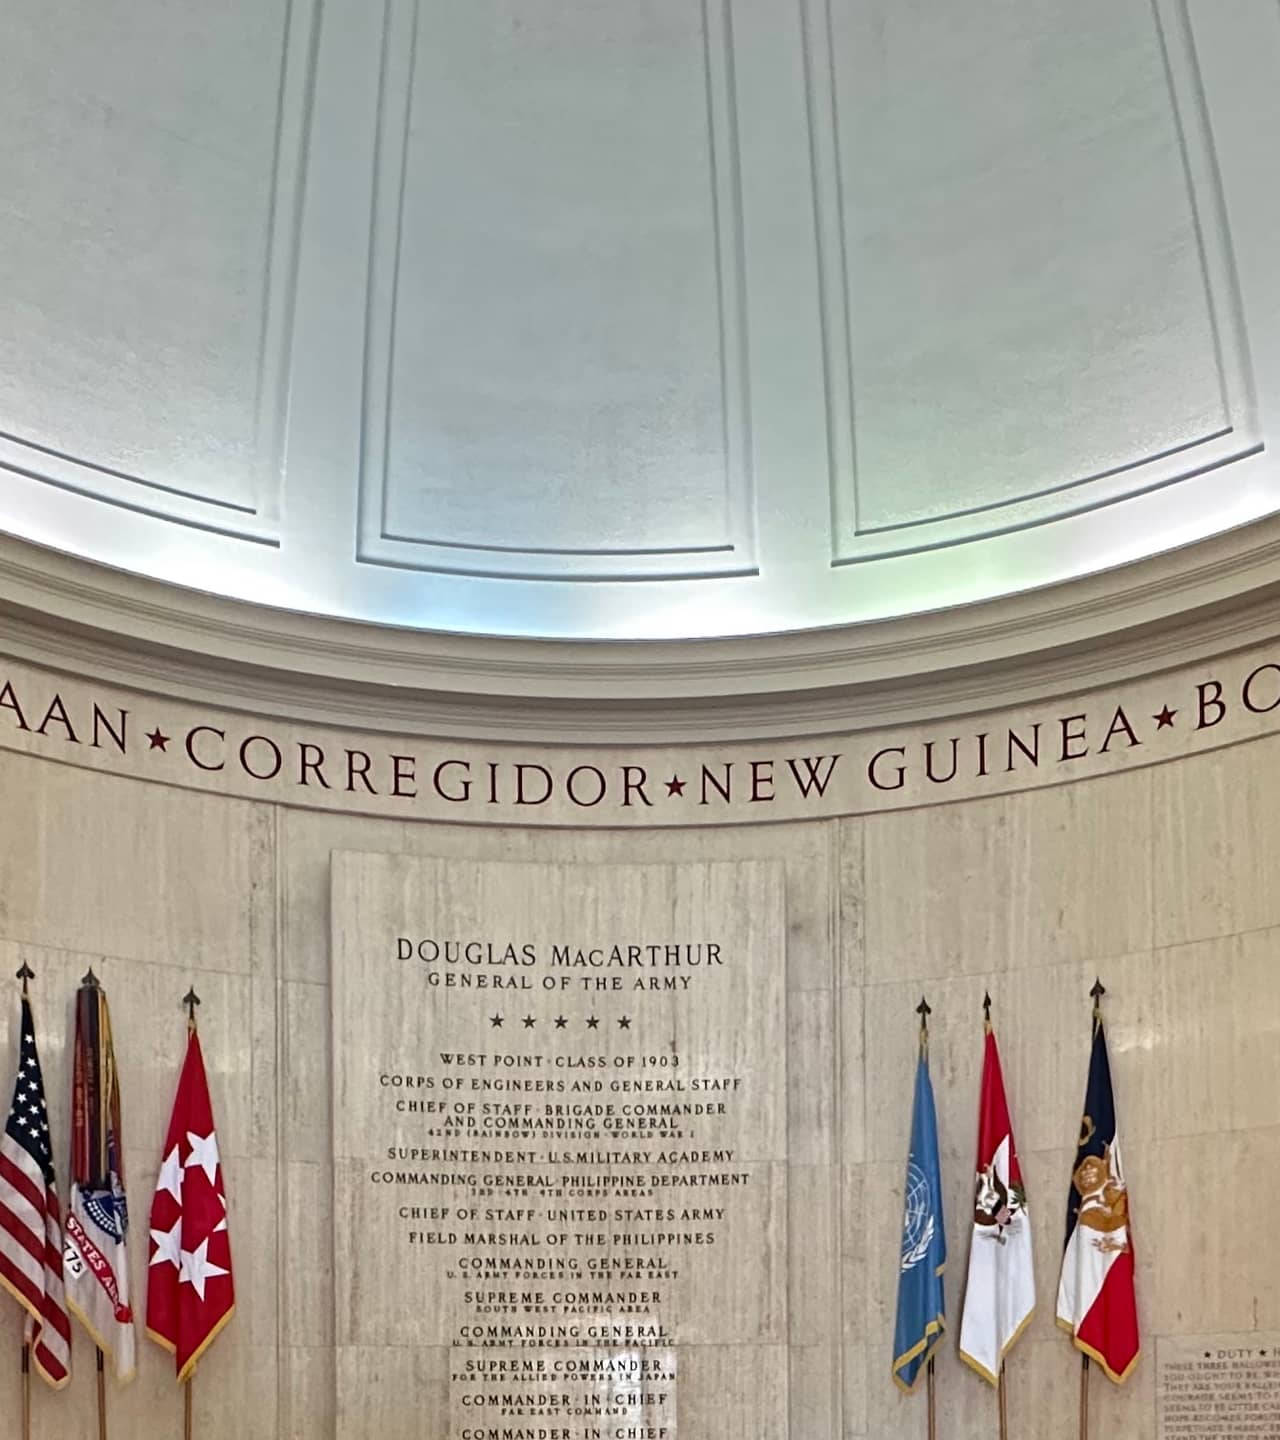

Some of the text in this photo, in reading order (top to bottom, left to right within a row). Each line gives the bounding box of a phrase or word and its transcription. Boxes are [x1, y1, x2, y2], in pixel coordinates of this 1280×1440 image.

[185, 726, 653, 807] CORREGIDOR
[699, 754, 843, 804] NEW
[868, 704, 1143, 791] GUINEA
[397, 938, 536, 967] DOUGLAS
[428, 972, 692, 990] GENERAL OF THE ARMY
[440, 1053, 680, 1068] WEST POINT CLASS OF 1903
[380, 1075, 742, 1092] CORPS OF ENGINEERS AND GENERAL STAFF
[396, 1100, 726, 1116] CHIEF OF STAFF BRIGADE COMMANDER
[444, 1116, 679, 1129] AND COMMANDING GENERAL
[387, 1148, 536, 1163] SUPERINTENDENT
[576, 1151, 652, 1164] MILITARY
[657, 1150, 734, 1163] ACADEMY
[371, 1172, 750, 1187] COMMANDING GENERAL PHILIPPINE DEPARTMENT
[399, 1207, 725, 1221] CHIEF OF STAFF UNITED STATES ARMY
[409, 1232, 715, 1246] FIELD MARSHAL OF THE PHILIPPINES
[458, 1258, 668, 1270] COMMANDING GENERAL
[464, 1292, 661, 1304] SUPREME COMMANDER
[460, 1326, 668, 1338] COMMANDING GENERAL
[1217, 1349, 1253, 1360] DUTY
[465, 1360, 662, 1372] SUPREME COMMANDER
[462, 1394, 668, 1406] COMMANDER IN CHIEF
[462, 1428, 668, 1440] COMMANDER IN CHIEF
